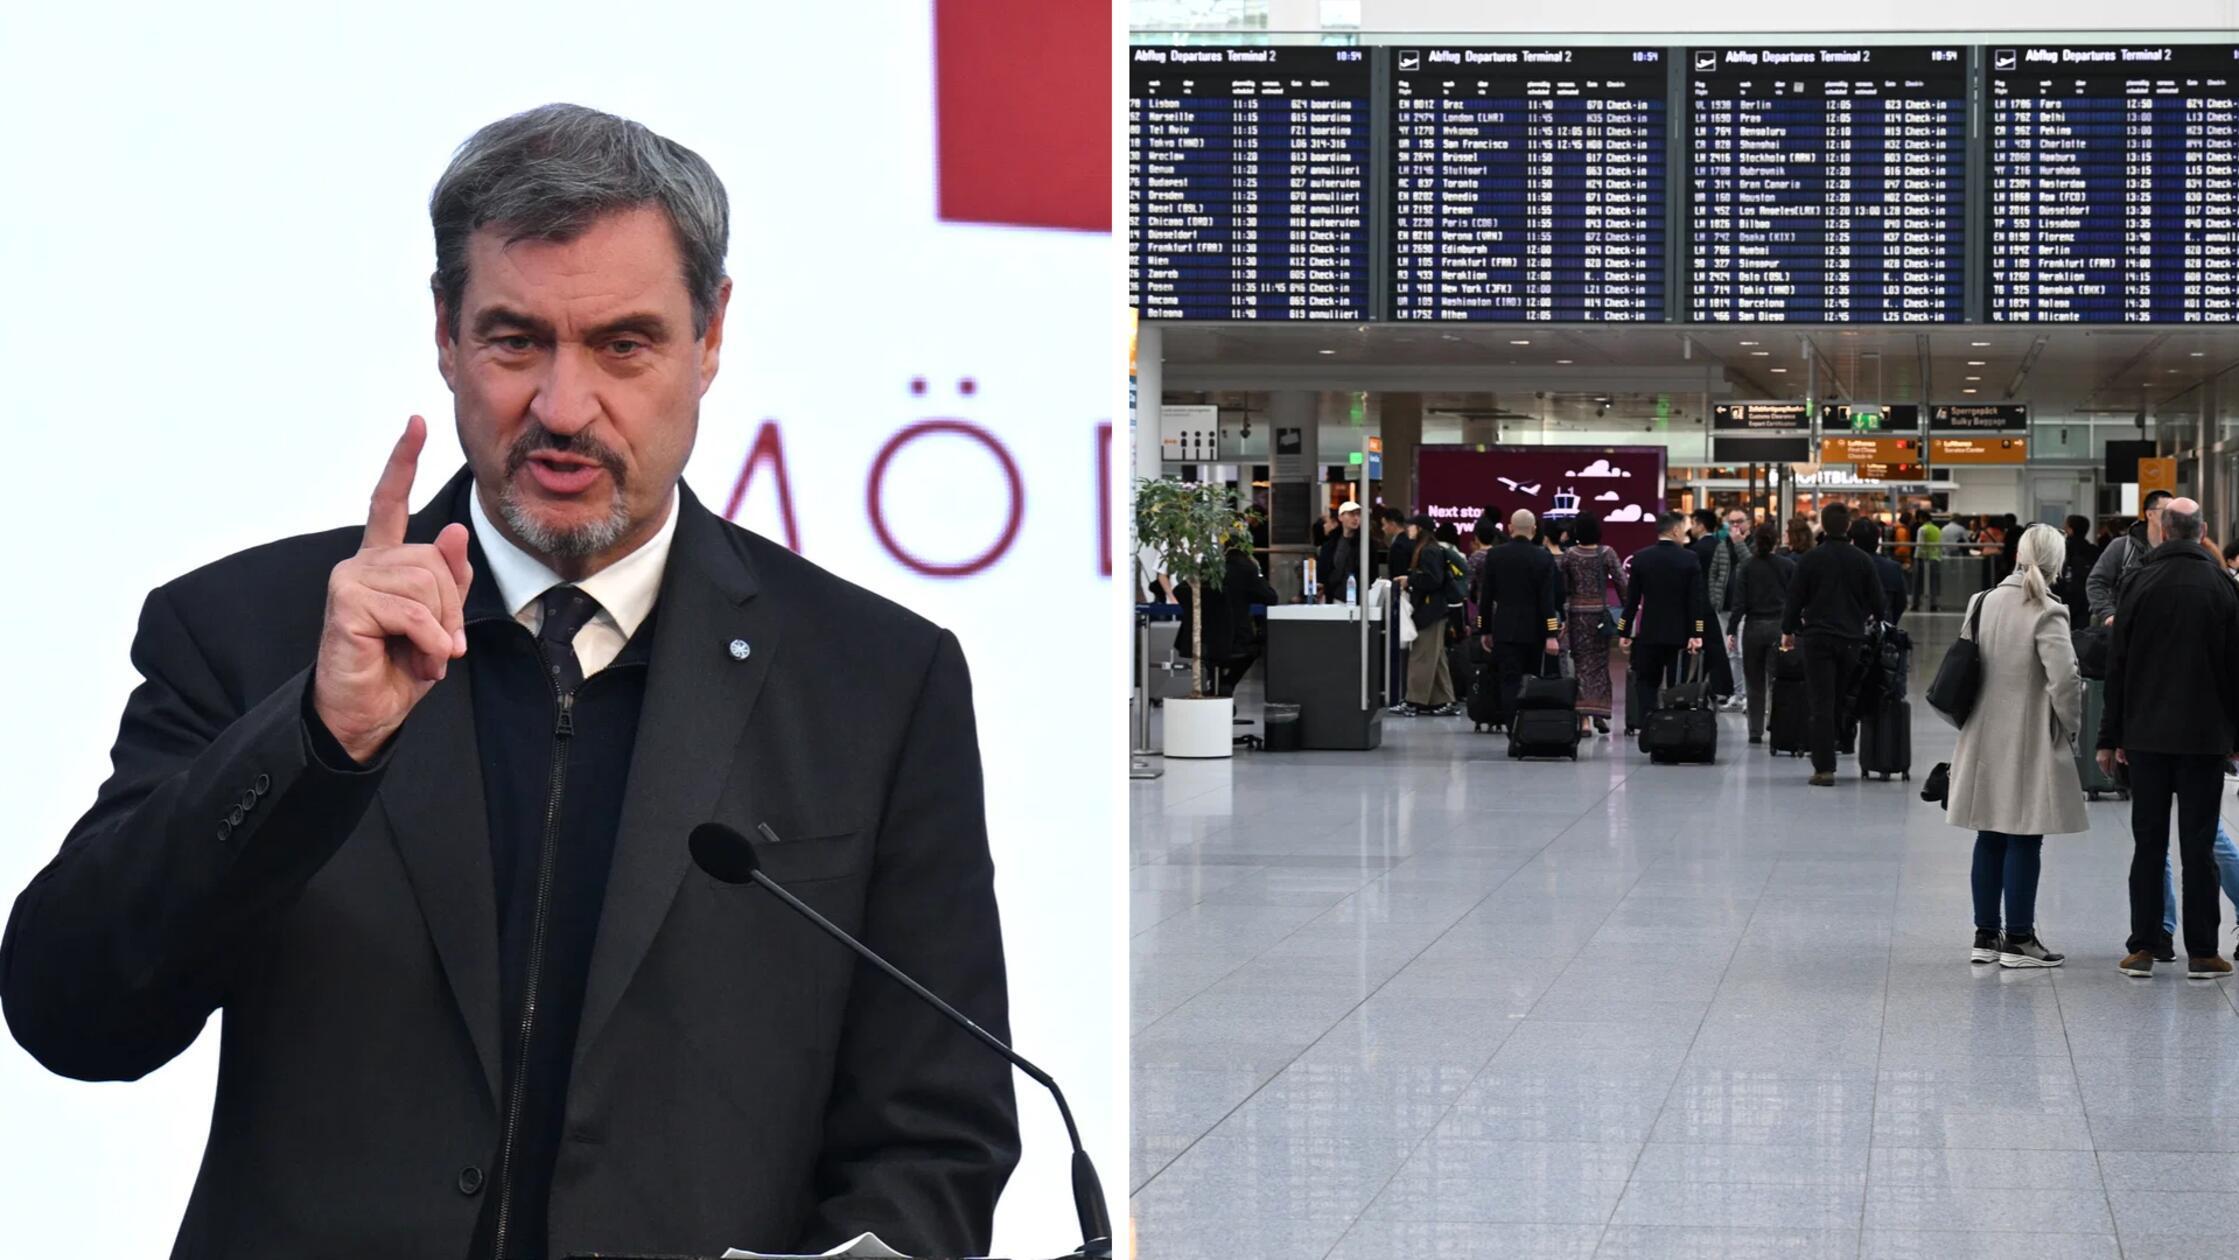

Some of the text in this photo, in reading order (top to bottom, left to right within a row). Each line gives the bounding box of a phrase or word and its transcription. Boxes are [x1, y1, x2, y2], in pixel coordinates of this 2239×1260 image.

[1135, 50, 1276, 63] Abflug Departures Terminal 2
[1337, 51, 1362, 61] 10:54
[1429, 50, 1572, 64] Abflug Departures Terminal 2
[1633, 52, 1658, 61] 10:54
[1726, 50, 1870, 64] Abflug Departures Terminal 2
[1932, 51, 1957, 60] 10:54
[2025, 49, 2171, 63] Abflug Departures Terminal 2
[1234, 100, 1258, 108] 11:15
[1607, 101, 1647, 109] Check-in
[1905, 100, 1946, 109] Check-in
[1234, 113, 1258, 121] 11:15
[1234, 126, 1258, 134] 11:15
[1234, 139, 1258, 148] 11:15
[1606, 141, 1647, 149] Check-in
[1905, 140, 1946, 149] Check-in
[2127, 152, 2151, 161] 13:15
[2127, 166, 2151, 175] 13:15
[1233, 178, 1257, 187] 11:25
[1606, 180, 1646, 189] Check-in
[1904, 180, 1946, 189] Check-in
[2127, 179, 2151, 188] 13:25
[1233, 191, 1257, 200] 11:25
[2126, 192, 2151, 202] 13:25
[1528, 206, 1552, 215] 11:55
[1528, 219, 1552, 228] 11:55
[1605, 220, 1646, 228] Check-in
[1825, 219, 1850, 228] 12:25
[1904, 220, 1945, 228] Check-in
[2126, 219, 2151, 228] 13:35
[1310, 232, 1350, 240] Check-in
[1527, 232, 1552, 241] 11:55
[1825, 233, 1850, 242] 12:25
[1310, 245, 1350, 253] Check-in
[1605, 259, 1646, 267] Check-in
[1904, 259, 1945, 268] Check-in
[1825, 272, 1849, 281] 12:35
[1232, 283, 1256, 292] 11:35
[1309, 284, 1349, 292] Check-in
[1825, 285, 1849, 294] 12:35
[1309, 297, 1349, 305] Check-in
[1604, 299, 1645, 307] Check-in
[1904, 299, 1945, 308] Check-in
[1951, 406, 1998, 416] Sperrgepäck
[1951, 417, 1972, 427] Bulky
[1429, 505, 1459, 518] Next
